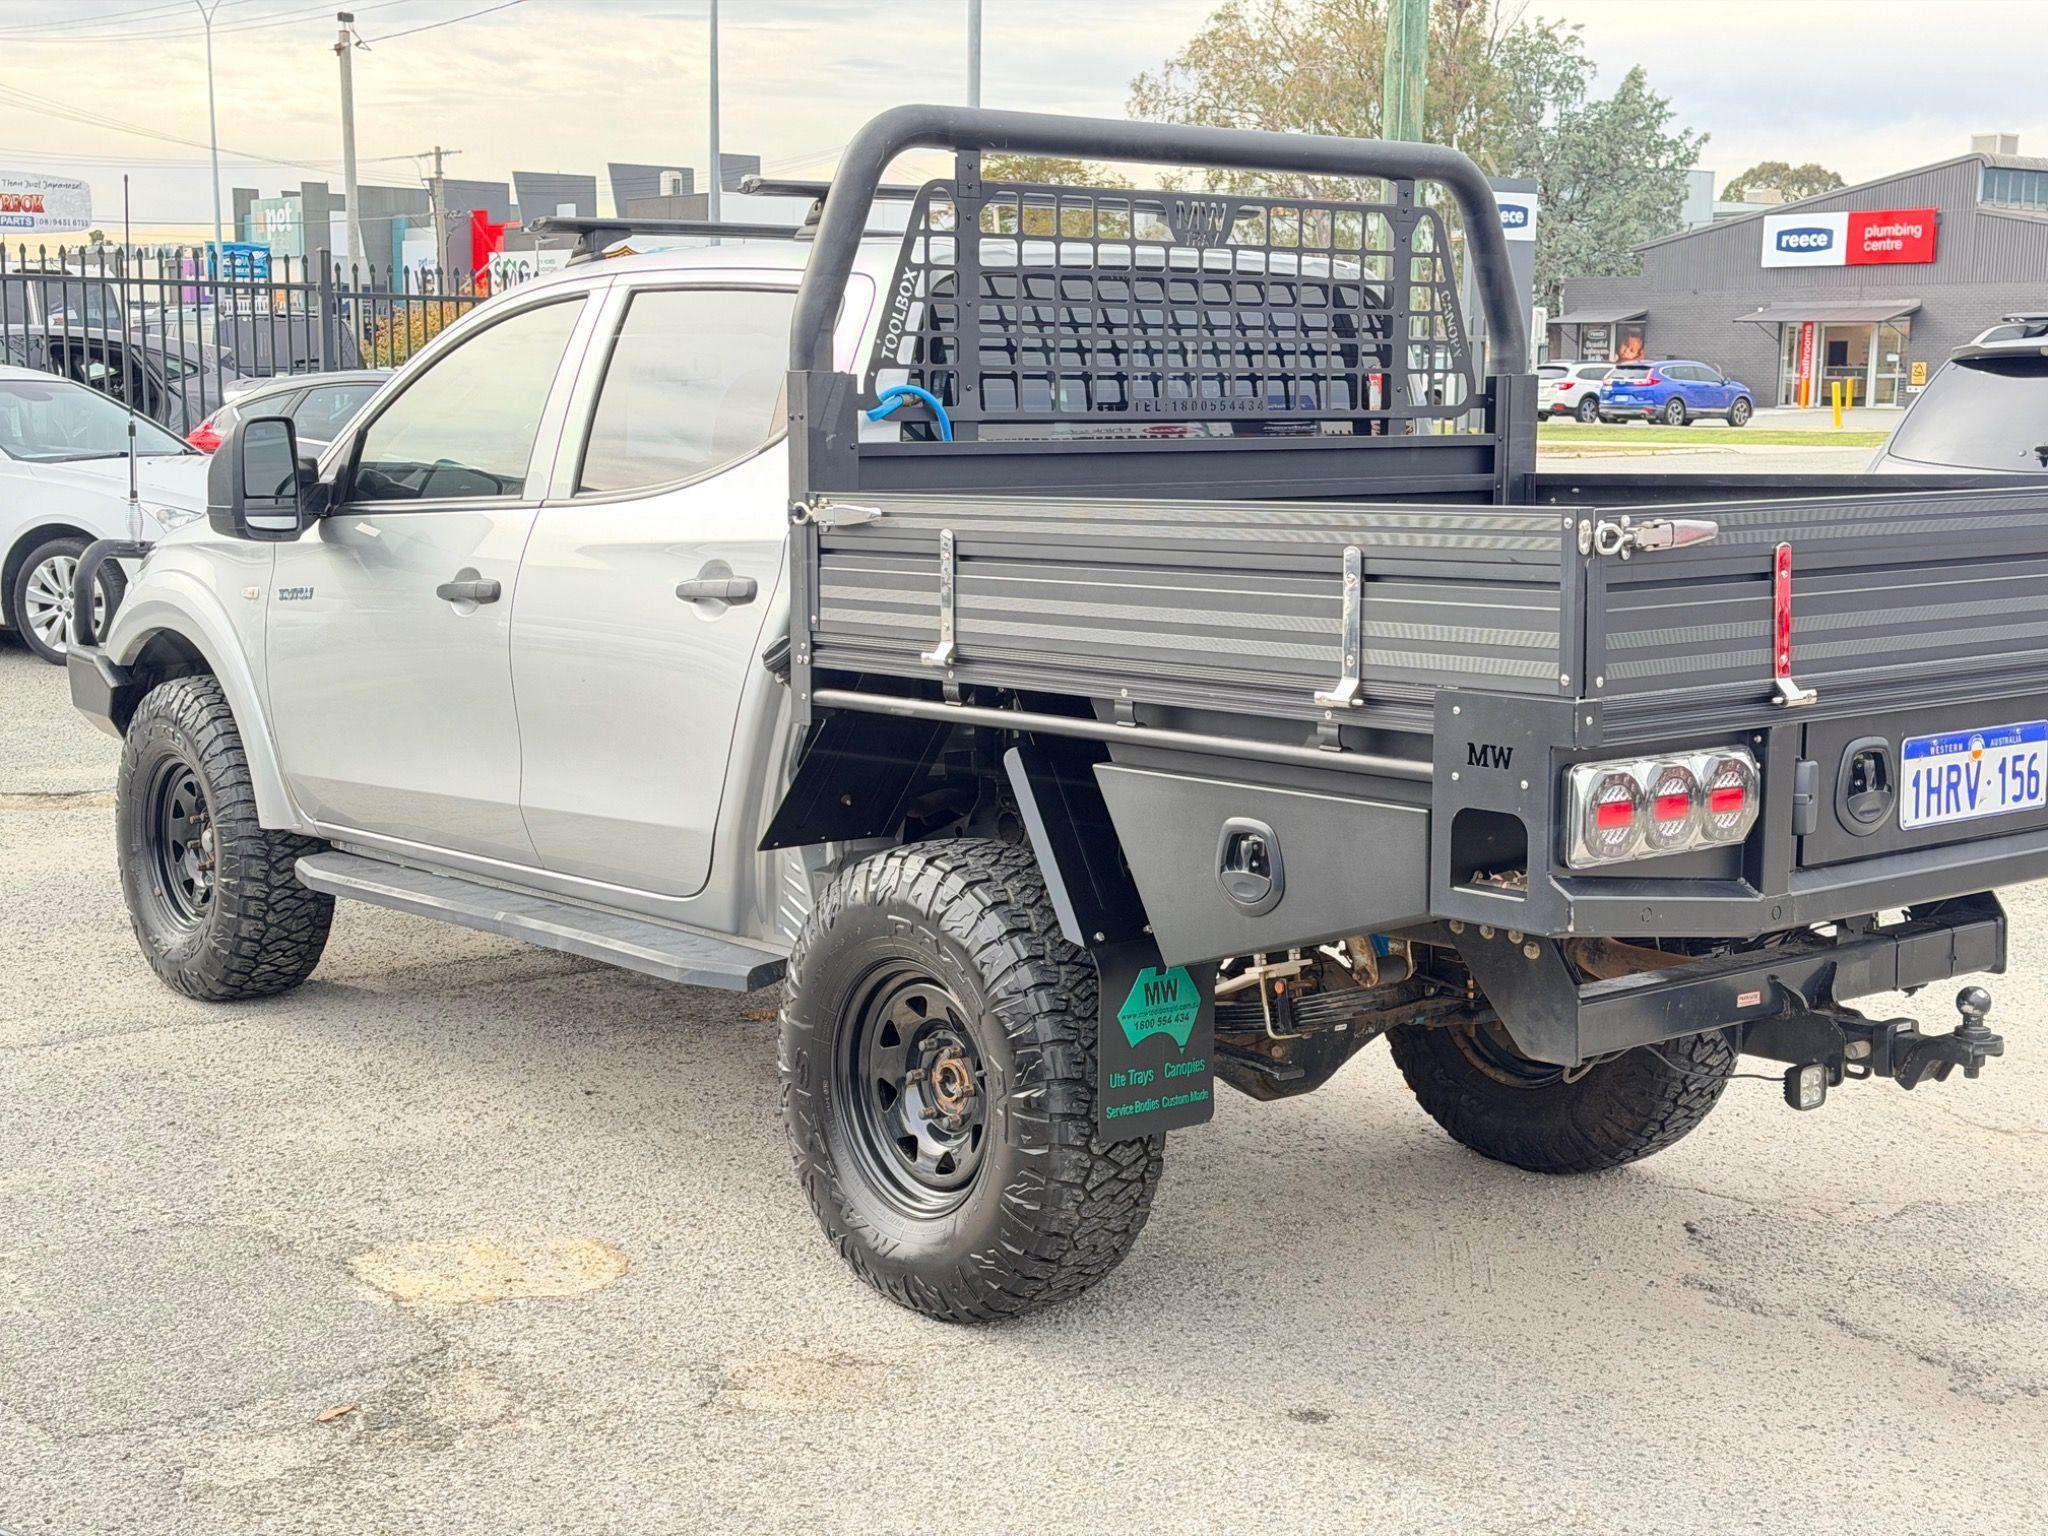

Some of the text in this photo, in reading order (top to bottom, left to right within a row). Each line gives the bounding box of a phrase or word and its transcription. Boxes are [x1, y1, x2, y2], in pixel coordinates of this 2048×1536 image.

[0, 215, 33, 227] PARTS
[1176, 200, 1227, 232] MW
[1500, 210, 1525, 224] ece
[1781, 233, 1828, 248] reece
[1864, 224, 1923, 239] plumbing
[1863, 239, 1903, 251] centre
[881, 266, 918, 360] TOOLBOX
[1930, 735, 2022, 755] WESTERN AUSTRALIA
[1466, 742, 1514, 770] MW
[1143, 978, 1180, 1008] MW
[1134, 1012, 1190, 1031] 1800 554 434
[1109, 1057, 1206, 1089] Ute Trays Canopies
[1106, 1088, 1209, 1119] Service Bodies Custom Made
